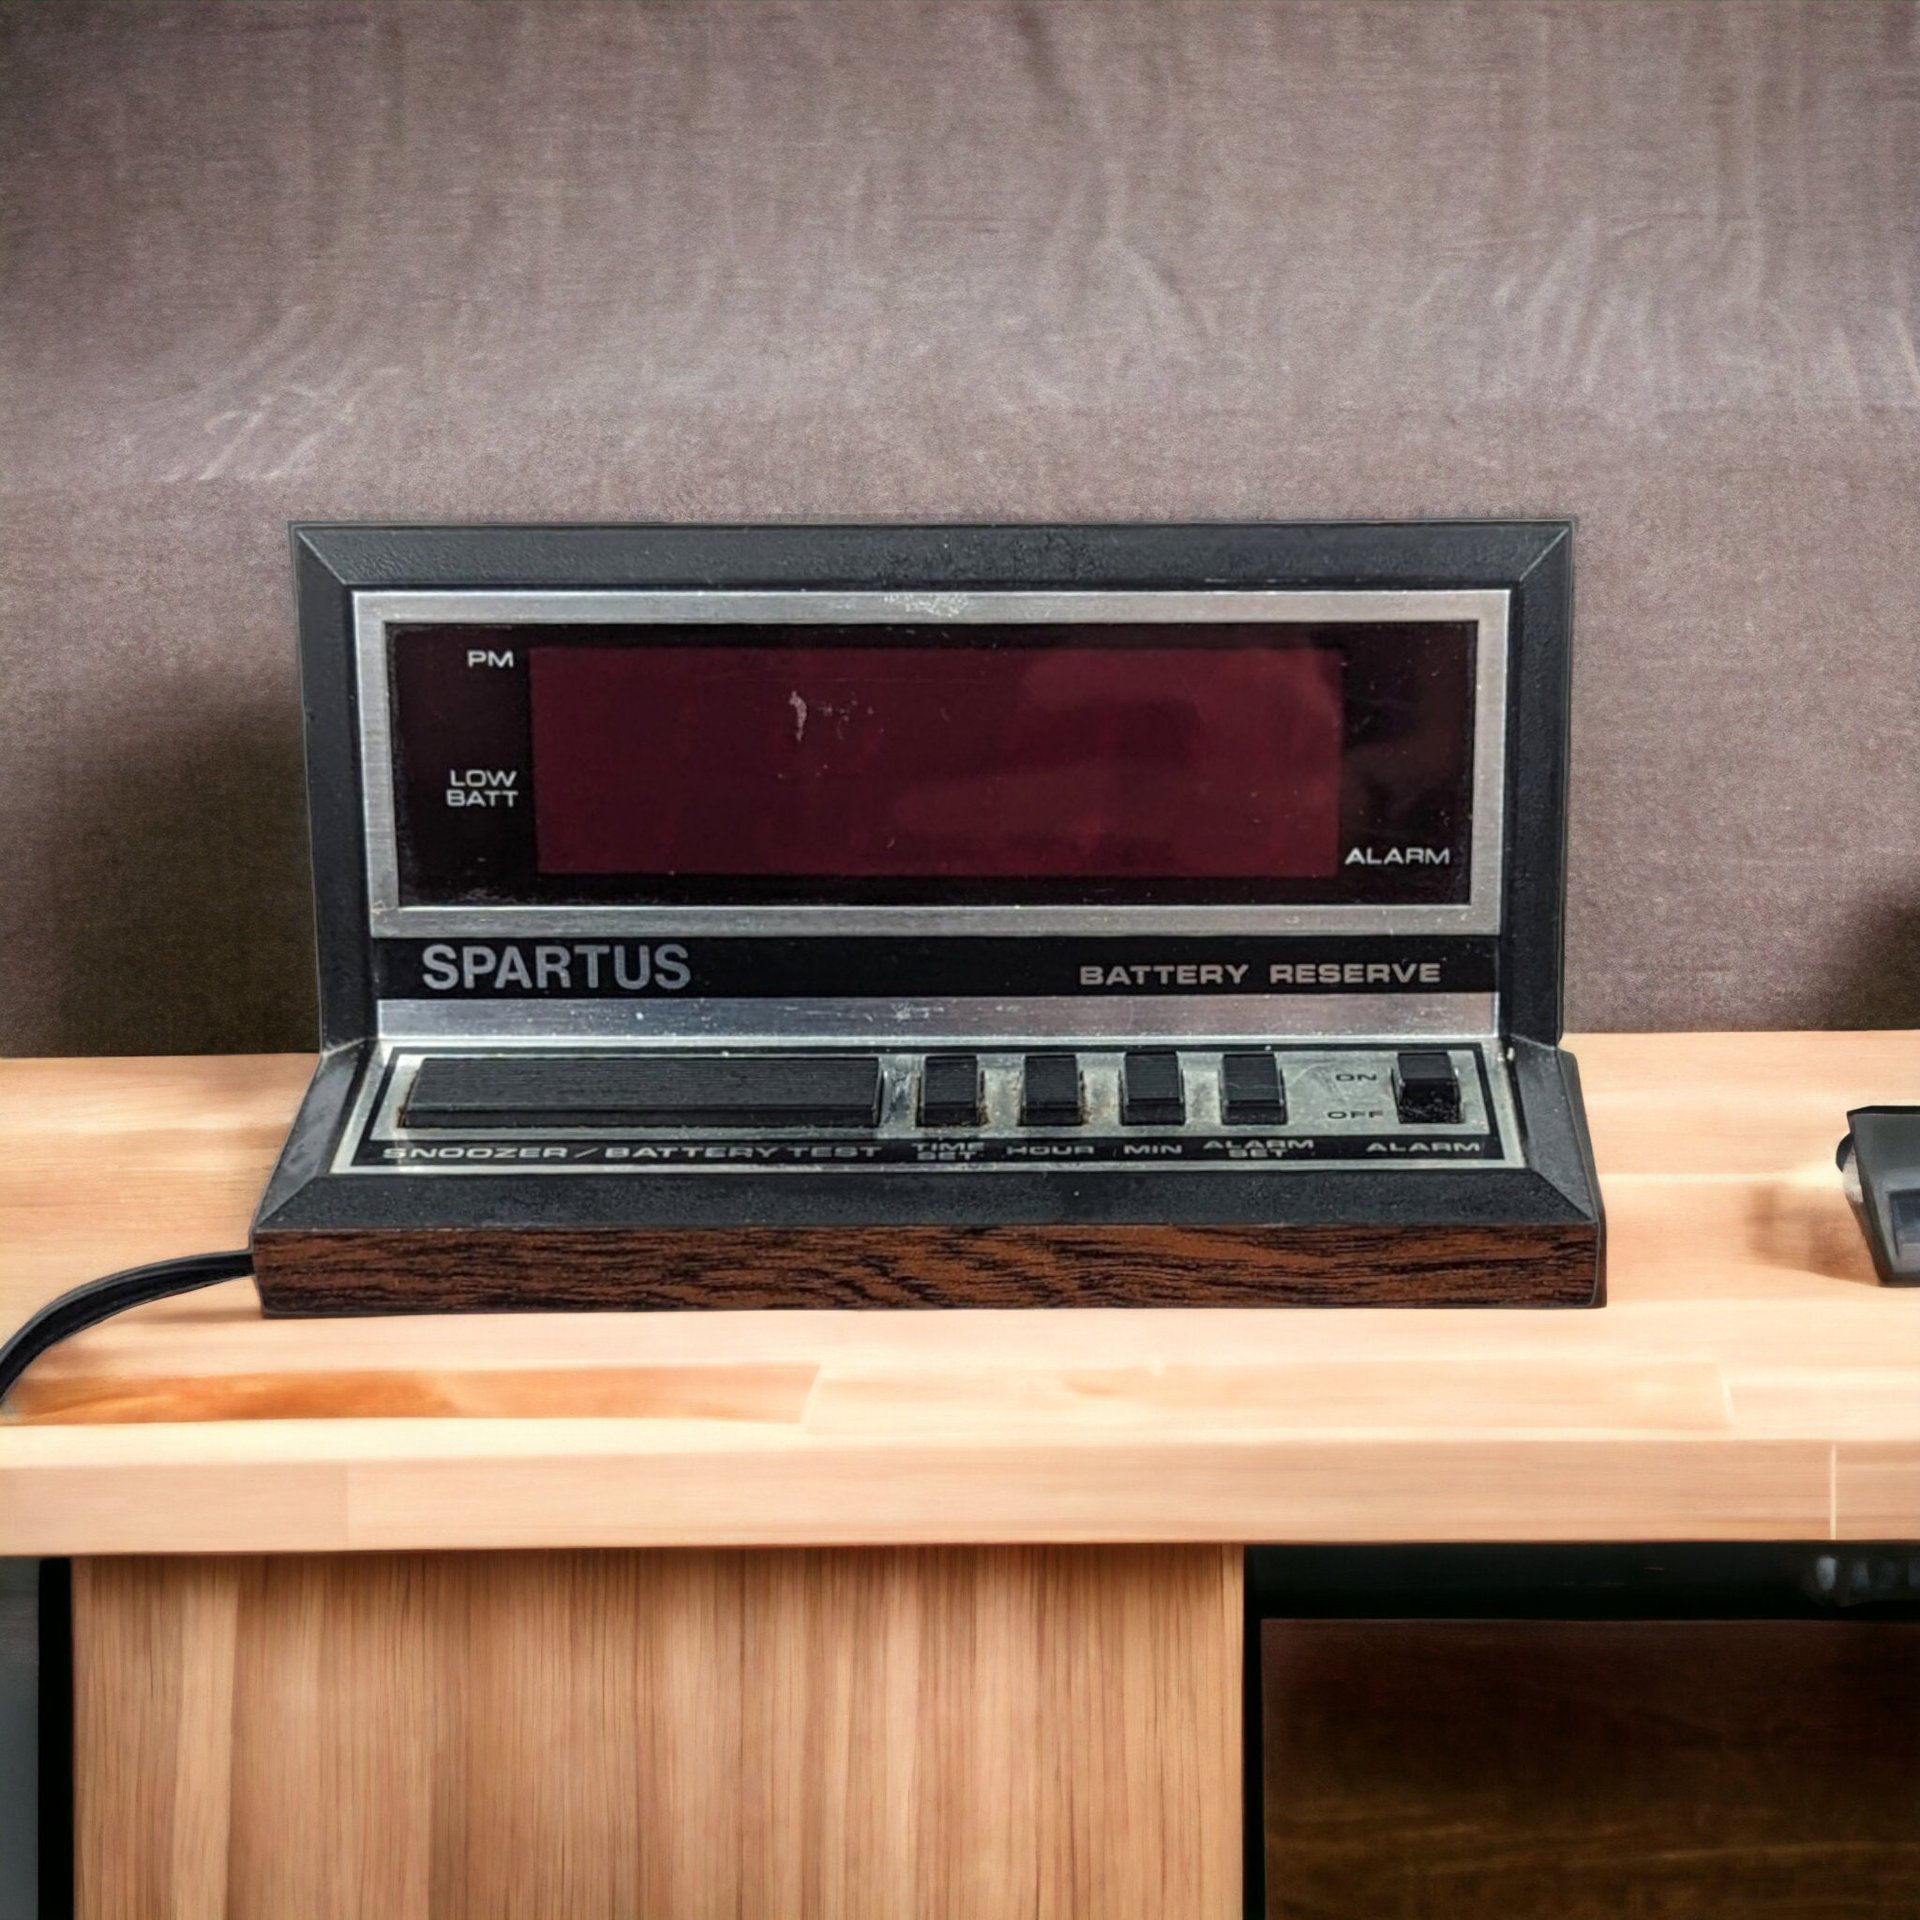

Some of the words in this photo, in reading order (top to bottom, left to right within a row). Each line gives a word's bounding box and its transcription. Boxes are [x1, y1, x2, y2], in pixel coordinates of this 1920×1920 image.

[467, 651, 514, 668] PM
[449, 770, 517, 788] LOW
[446, 790, 518, 807] BATT
[1345, 847, 1451, 866] ALARM
[422, 943, 692, 990] SPARTUS
[1080, 965, 1249, 986] BATTERY
[1269, 963, 1442, 984] RESERVE
[1335, 1073, 1377, 1082] ON
[1327, 1110, 1384, 1120] OFF
[912, 1142, 985, 1151] TIME
[1006, 1145, 1094, 1156] HOUR
[1123, 1144, 1183, 1155] MIN
[1203, 1139, 1315, 1150] ALARM
[1365, 1141, 1481, 1153] ALARM
[382, 1147, 568, 1159] SNOOZER
[604, 1147, 779, 1159] BATTERY
[789, 1146, 882, 1158] TEST
